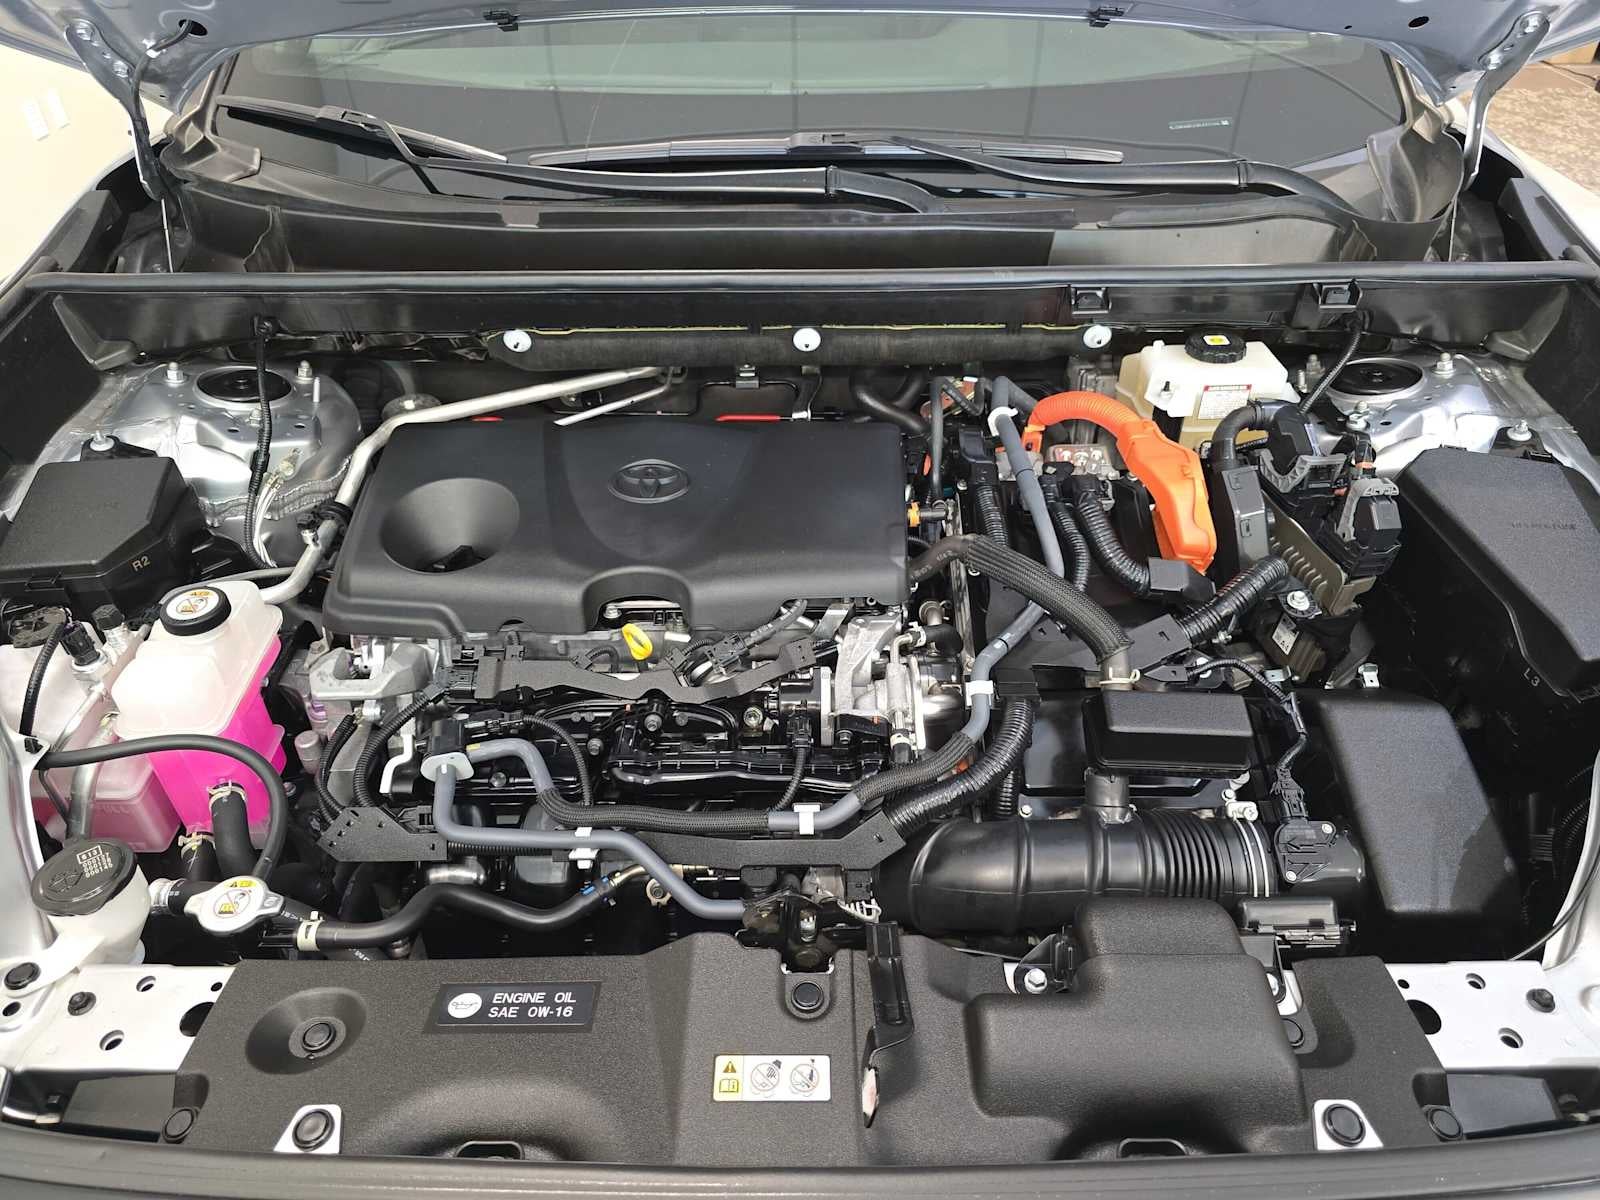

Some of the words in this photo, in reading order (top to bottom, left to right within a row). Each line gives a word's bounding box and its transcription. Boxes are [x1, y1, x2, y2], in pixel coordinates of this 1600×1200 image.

[131, 555, 150, 571] R2
[1523, 667, 1540, 687] L3
[492, 991, 546, 1004] ENGINE
[554, 991, 577, 1003] OIL
[487, 1006, 520, 1018] SAE
[527, 1006, 574, 1018] 0W-16
